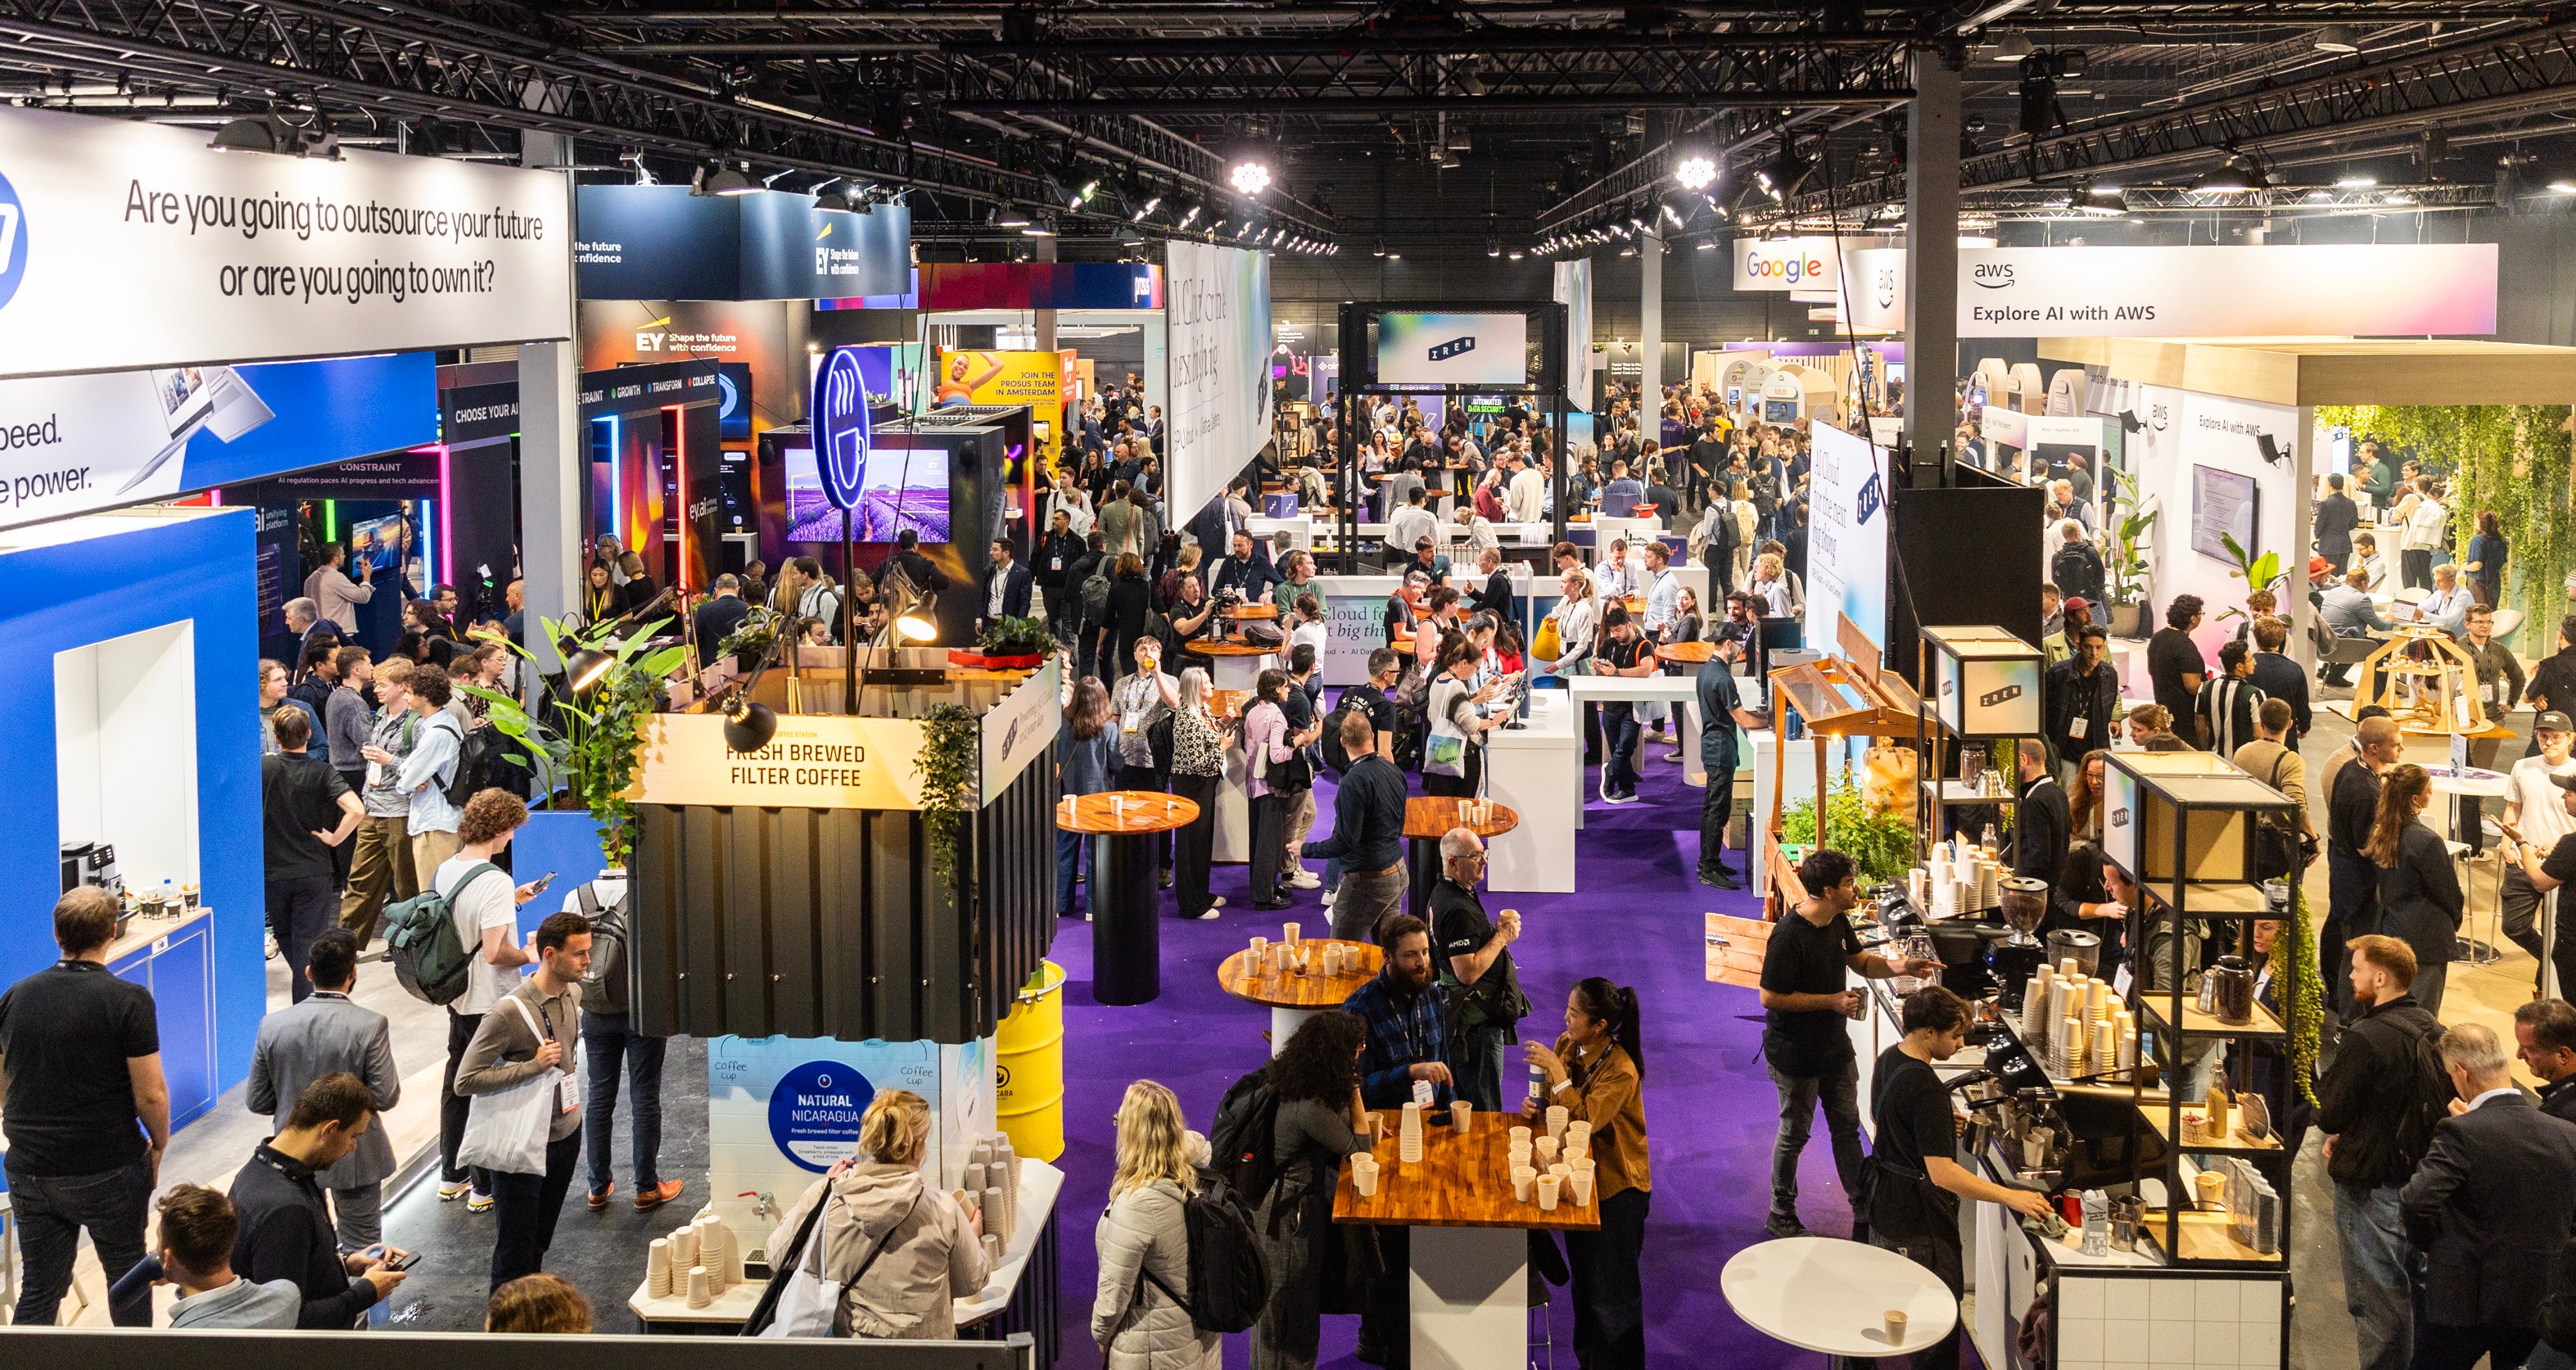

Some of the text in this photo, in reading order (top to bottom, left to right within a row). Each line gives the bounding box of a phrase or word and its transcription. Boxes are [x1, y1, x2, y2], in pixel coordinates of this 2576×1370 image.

[124, 179, 543, 244] Are you going to outsource your future
[592, 242, 621, 251] future
[575, 254, 621, 263] nfidence
[816, 247, 829, 274] EY
[1747, 251, 1821, 283] Google
[220, 259, 494, 304] or are you going to own it?
[1134, 276, 1150, 303] prosus
[1973, 305, 2155, 323] Explore AI with AWS
[636, 333, 736, 351] EY Shape the future
[690, 344, 736, 352] confidence
[1431, 339, 1471, 359] IREN
[617, 385, 641, 398] GROWTH
[653, 379, 682, 393] TRANSFORM
[693, 375, 715, 387] COLLAPSE
[455, 402, 518, 423] CHOOSE YOUR AI
[2199, 414, 2260, 436] Explore AI with AWS
[340, 463, 401, 472] CONSTRAINT
[1814, 449, 1840, 487] AI Cloud
[15, 467, 92, 508] power.
[265, 508, 287, 520] unifying
[689, 497, 707, 522] ey.ai
[1813, 481, 1846, 529] for the next
[265, 519, 289, 531] platform
[1812, 515, 1837, 566] big thing
[1373, 606, 1386, 621] fo
[1338, 623, 1360, 640] big
[1364, 623, 1385, 637] thi
[1982, 687, 2018, 705] IREN
[790, 744, 865, 762] BREWED
[731, 767, 861, 786] FILTER COFFEE
[1448, 939, 1464, 948] AMD
[798, 1094, 852, 1107] NATURAL
[792, 1110, 859, 1123] NICARAGUA
